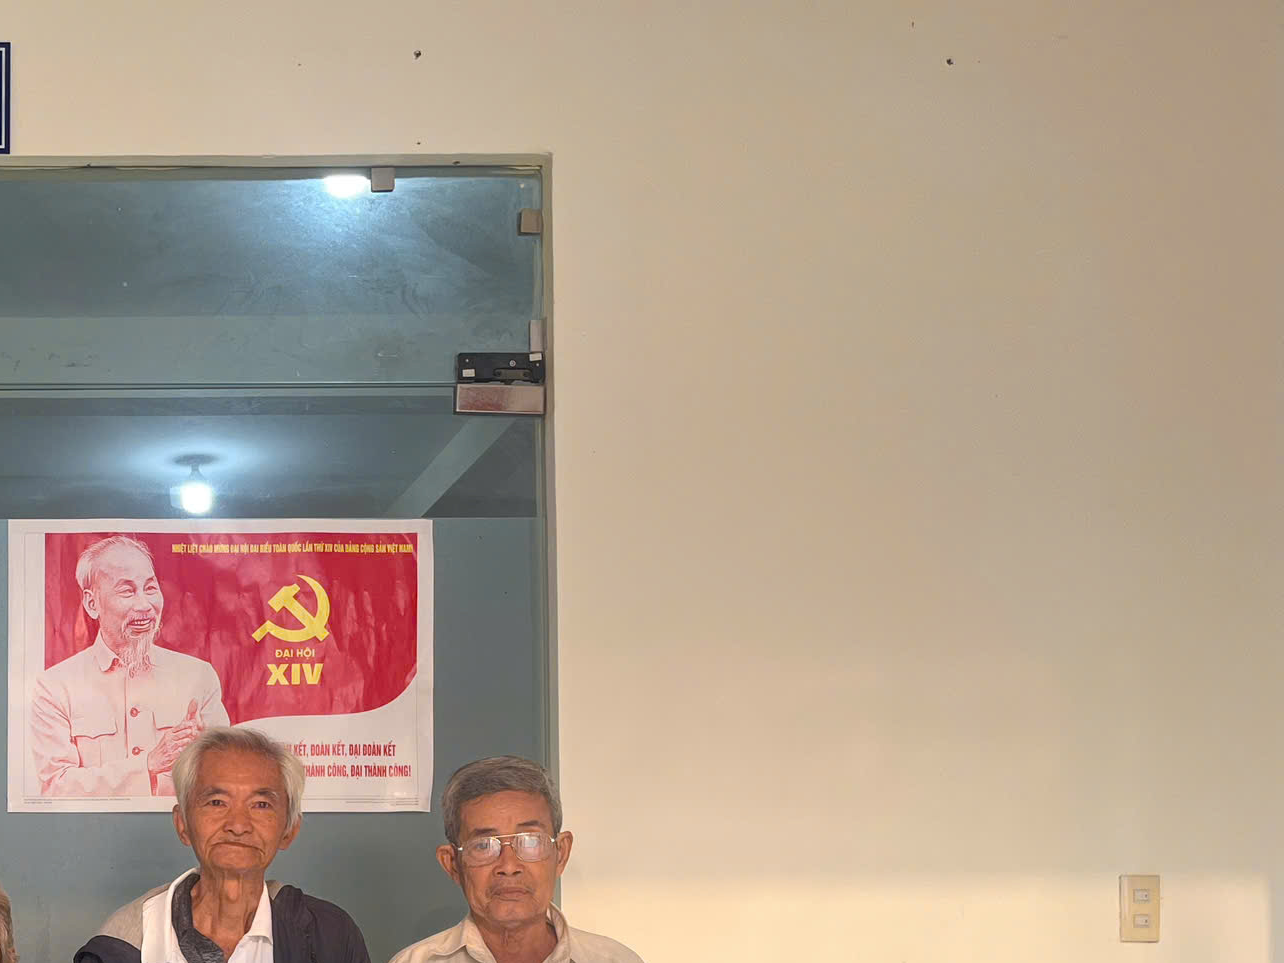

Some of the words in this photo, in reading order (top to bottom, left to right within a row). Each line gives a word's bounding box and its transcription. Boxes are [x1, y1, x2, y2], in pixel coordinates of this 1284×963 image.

[275, 649, 294, 660] ĐẠI
[296, 647, 315, 660] HỘI
[266, 663, 324, 686] XIV
[310, 741, 330, 756] ĐOÀN
[332, 739, 347, 757] KẾT,
[349, 743, 361, 759] ĐẠI
[363, 741, 382, 757] ĐOÀN
[383, 739, 396, 757] KẾT
[350, 764, 363, 780] ĐẠI
[364, 763, 387, 778] THÀNH
[388, 763, 412, 778] CÔNG!
